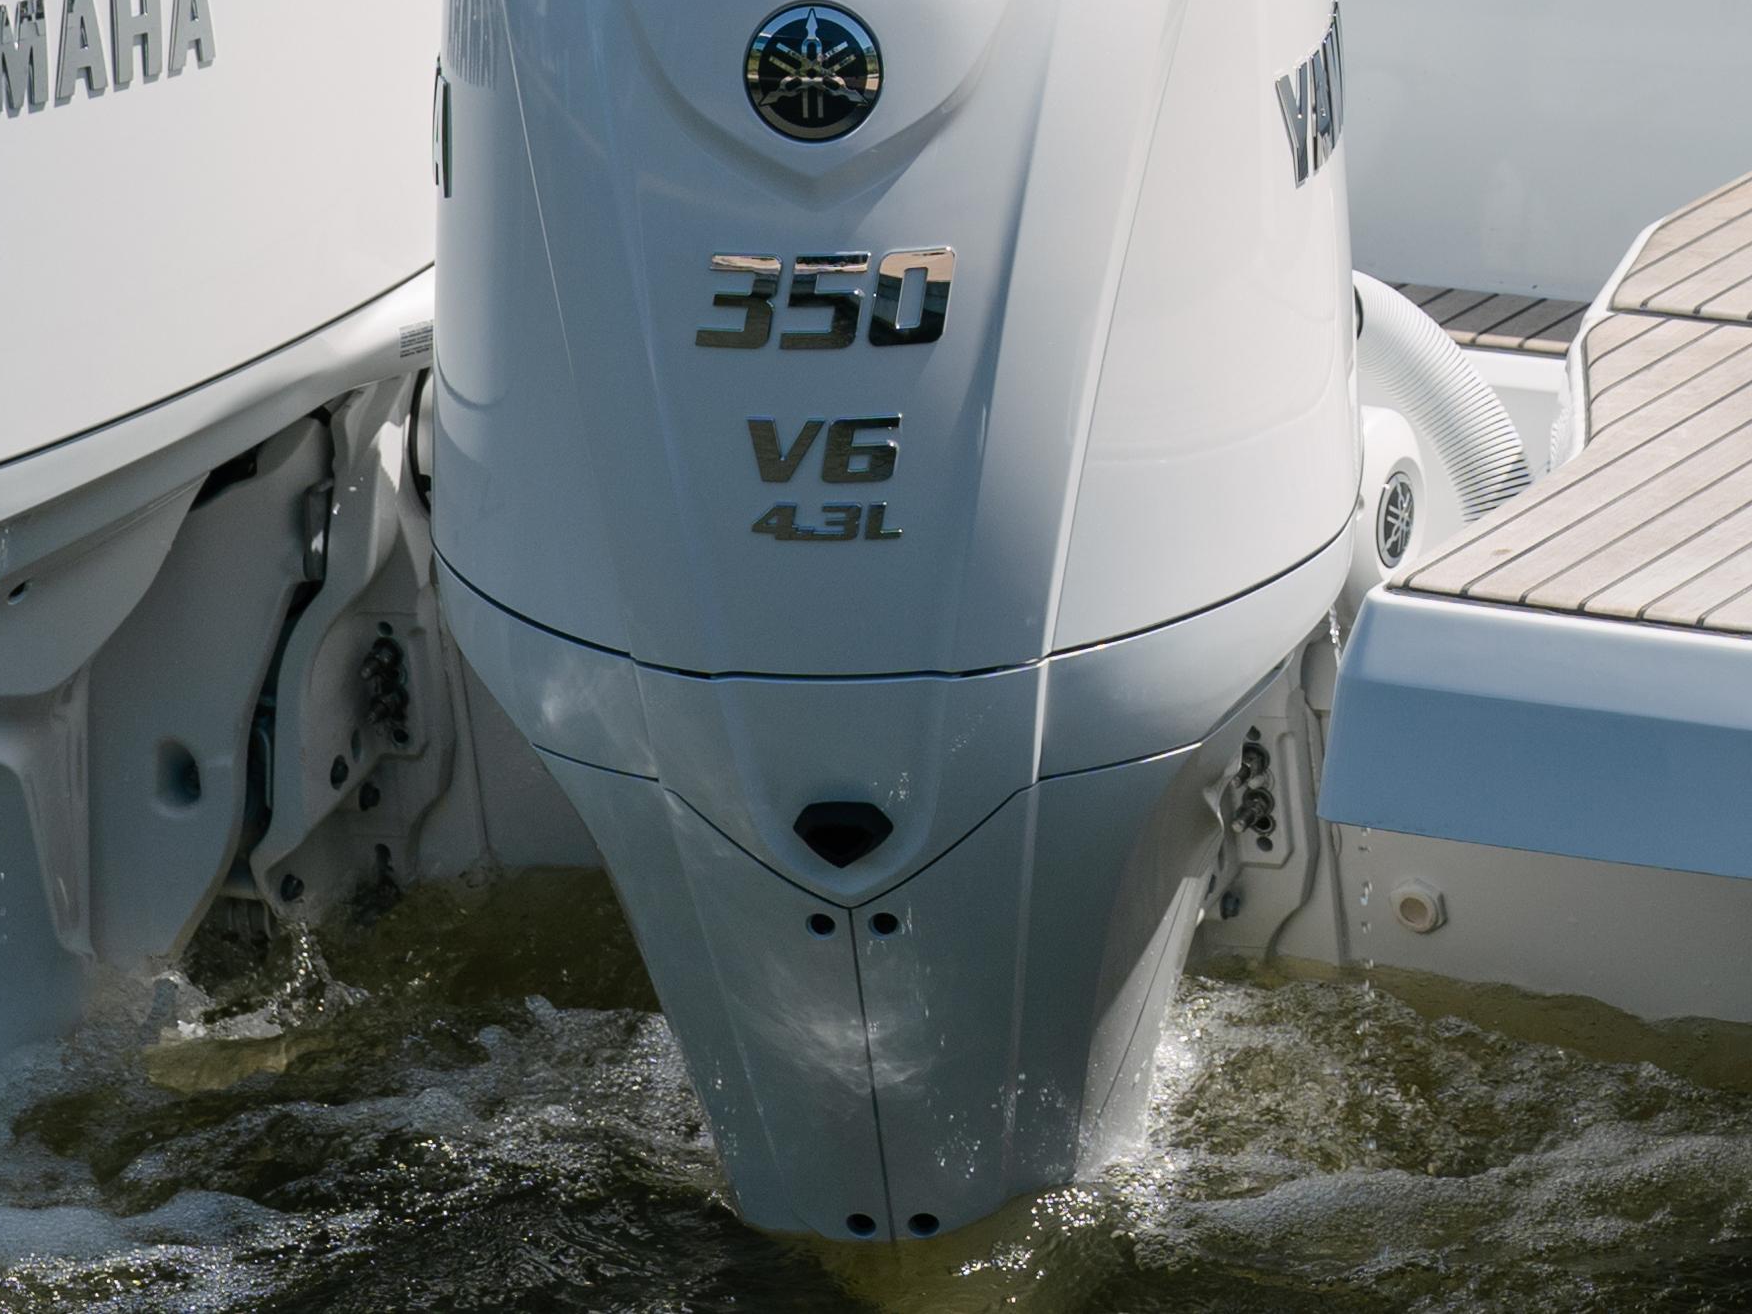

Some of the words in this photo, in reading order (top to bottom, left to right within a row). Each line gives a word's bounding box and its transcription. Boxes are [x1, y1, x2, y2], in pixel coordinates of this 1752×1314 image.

[695, 247, 957, 350] 350
[746, 413, 903, 483] V6
[751, 501, 903, 541] 4.3L
